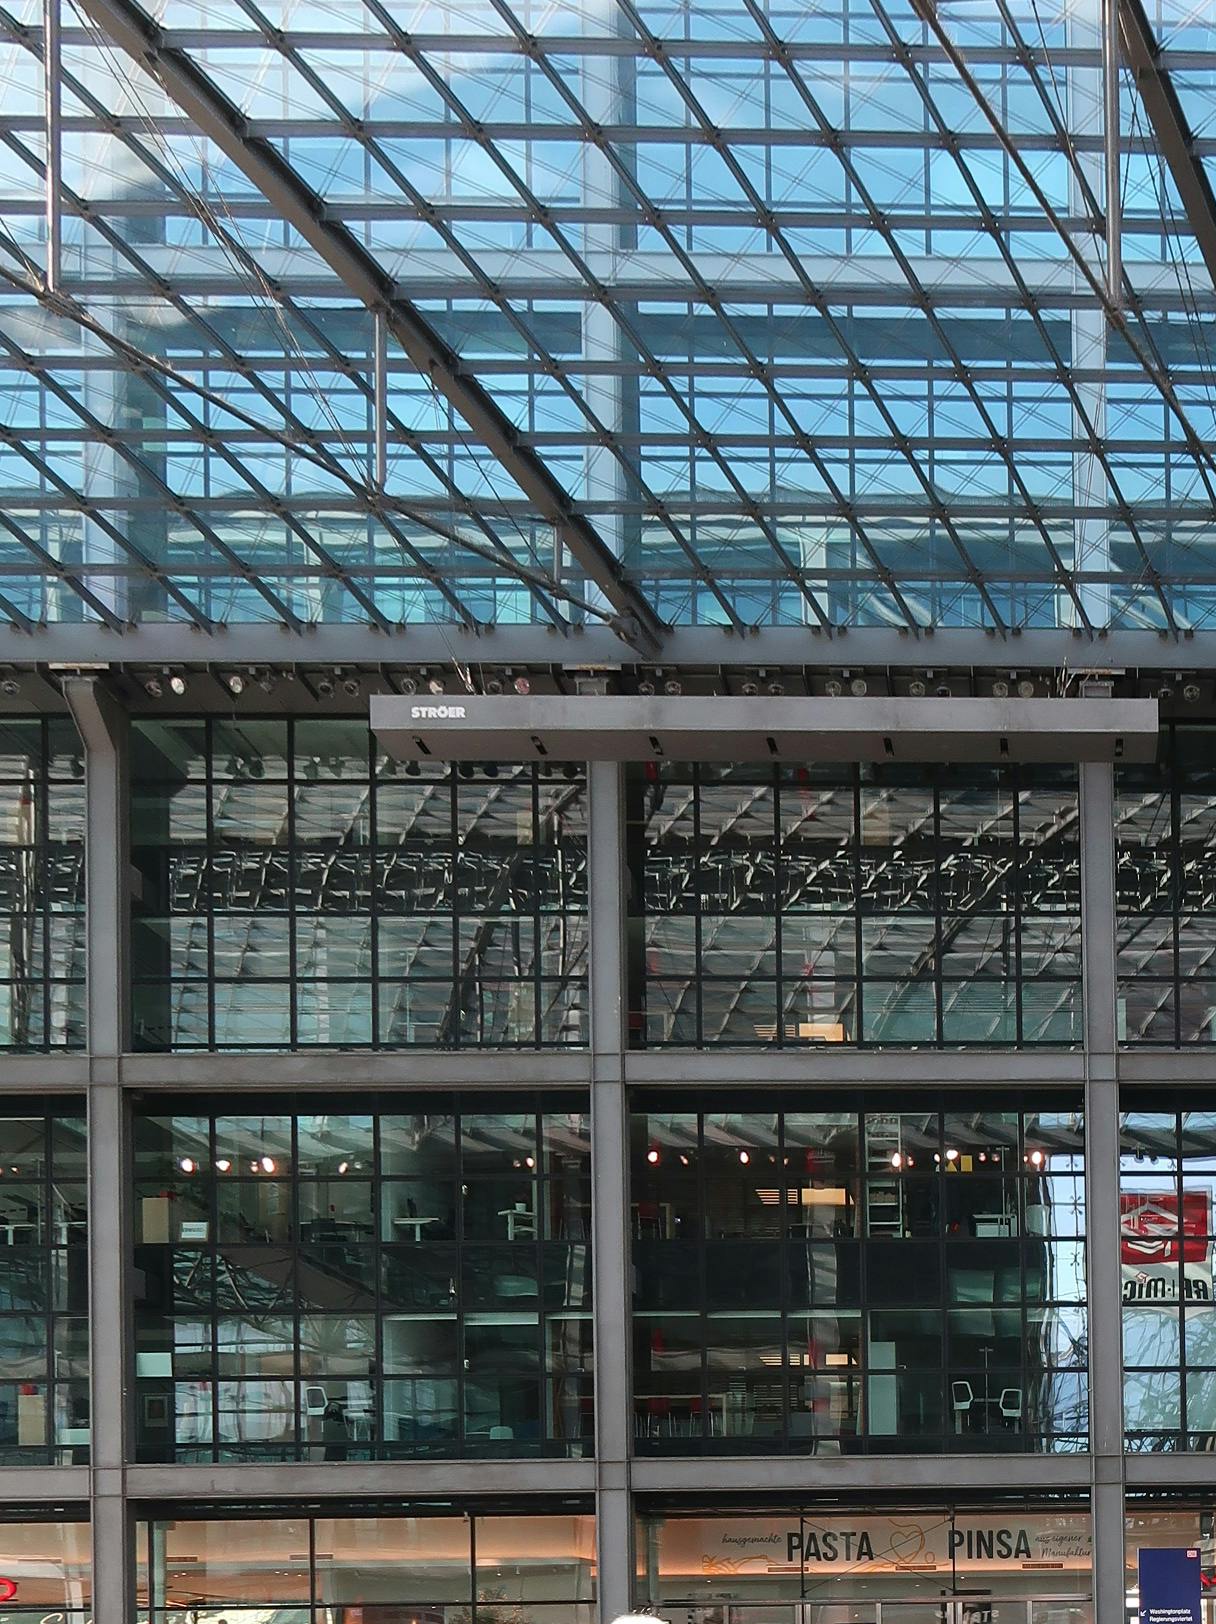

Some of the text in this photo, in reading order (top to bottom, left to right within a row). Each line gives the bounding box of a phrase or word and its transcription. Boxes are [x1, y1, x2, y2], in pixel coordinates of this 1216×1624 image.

[411, 705, 466, 718] STRÖER
[787, 1531, 874, 1562] PASTA
[948, 1529, 1032, 1560] PINSA
